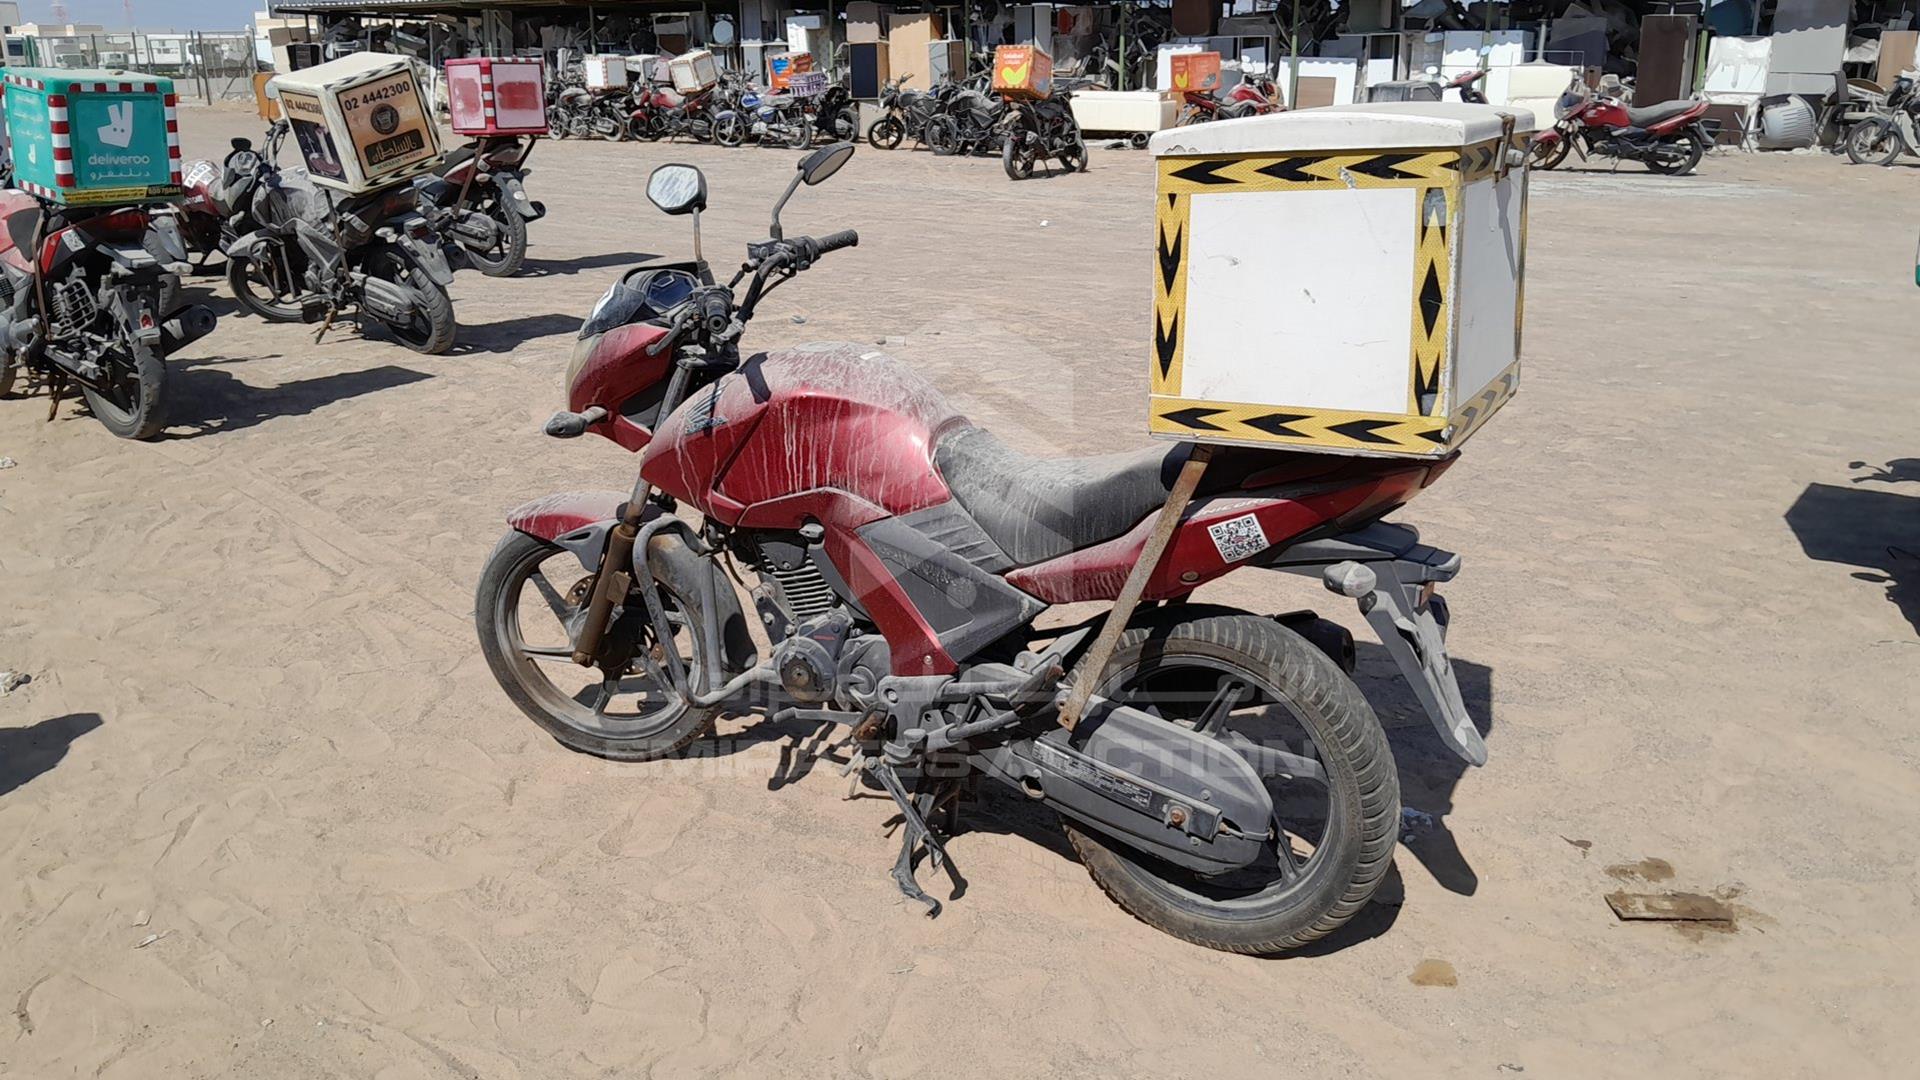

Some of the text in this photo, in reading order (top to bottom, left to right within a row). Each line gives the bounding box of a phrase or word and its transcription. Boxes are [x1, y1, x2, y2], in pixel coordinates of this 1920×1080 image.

[344, 81, 411, 111] 02 4442300
[88, 153, 151, 166] deliveroo
